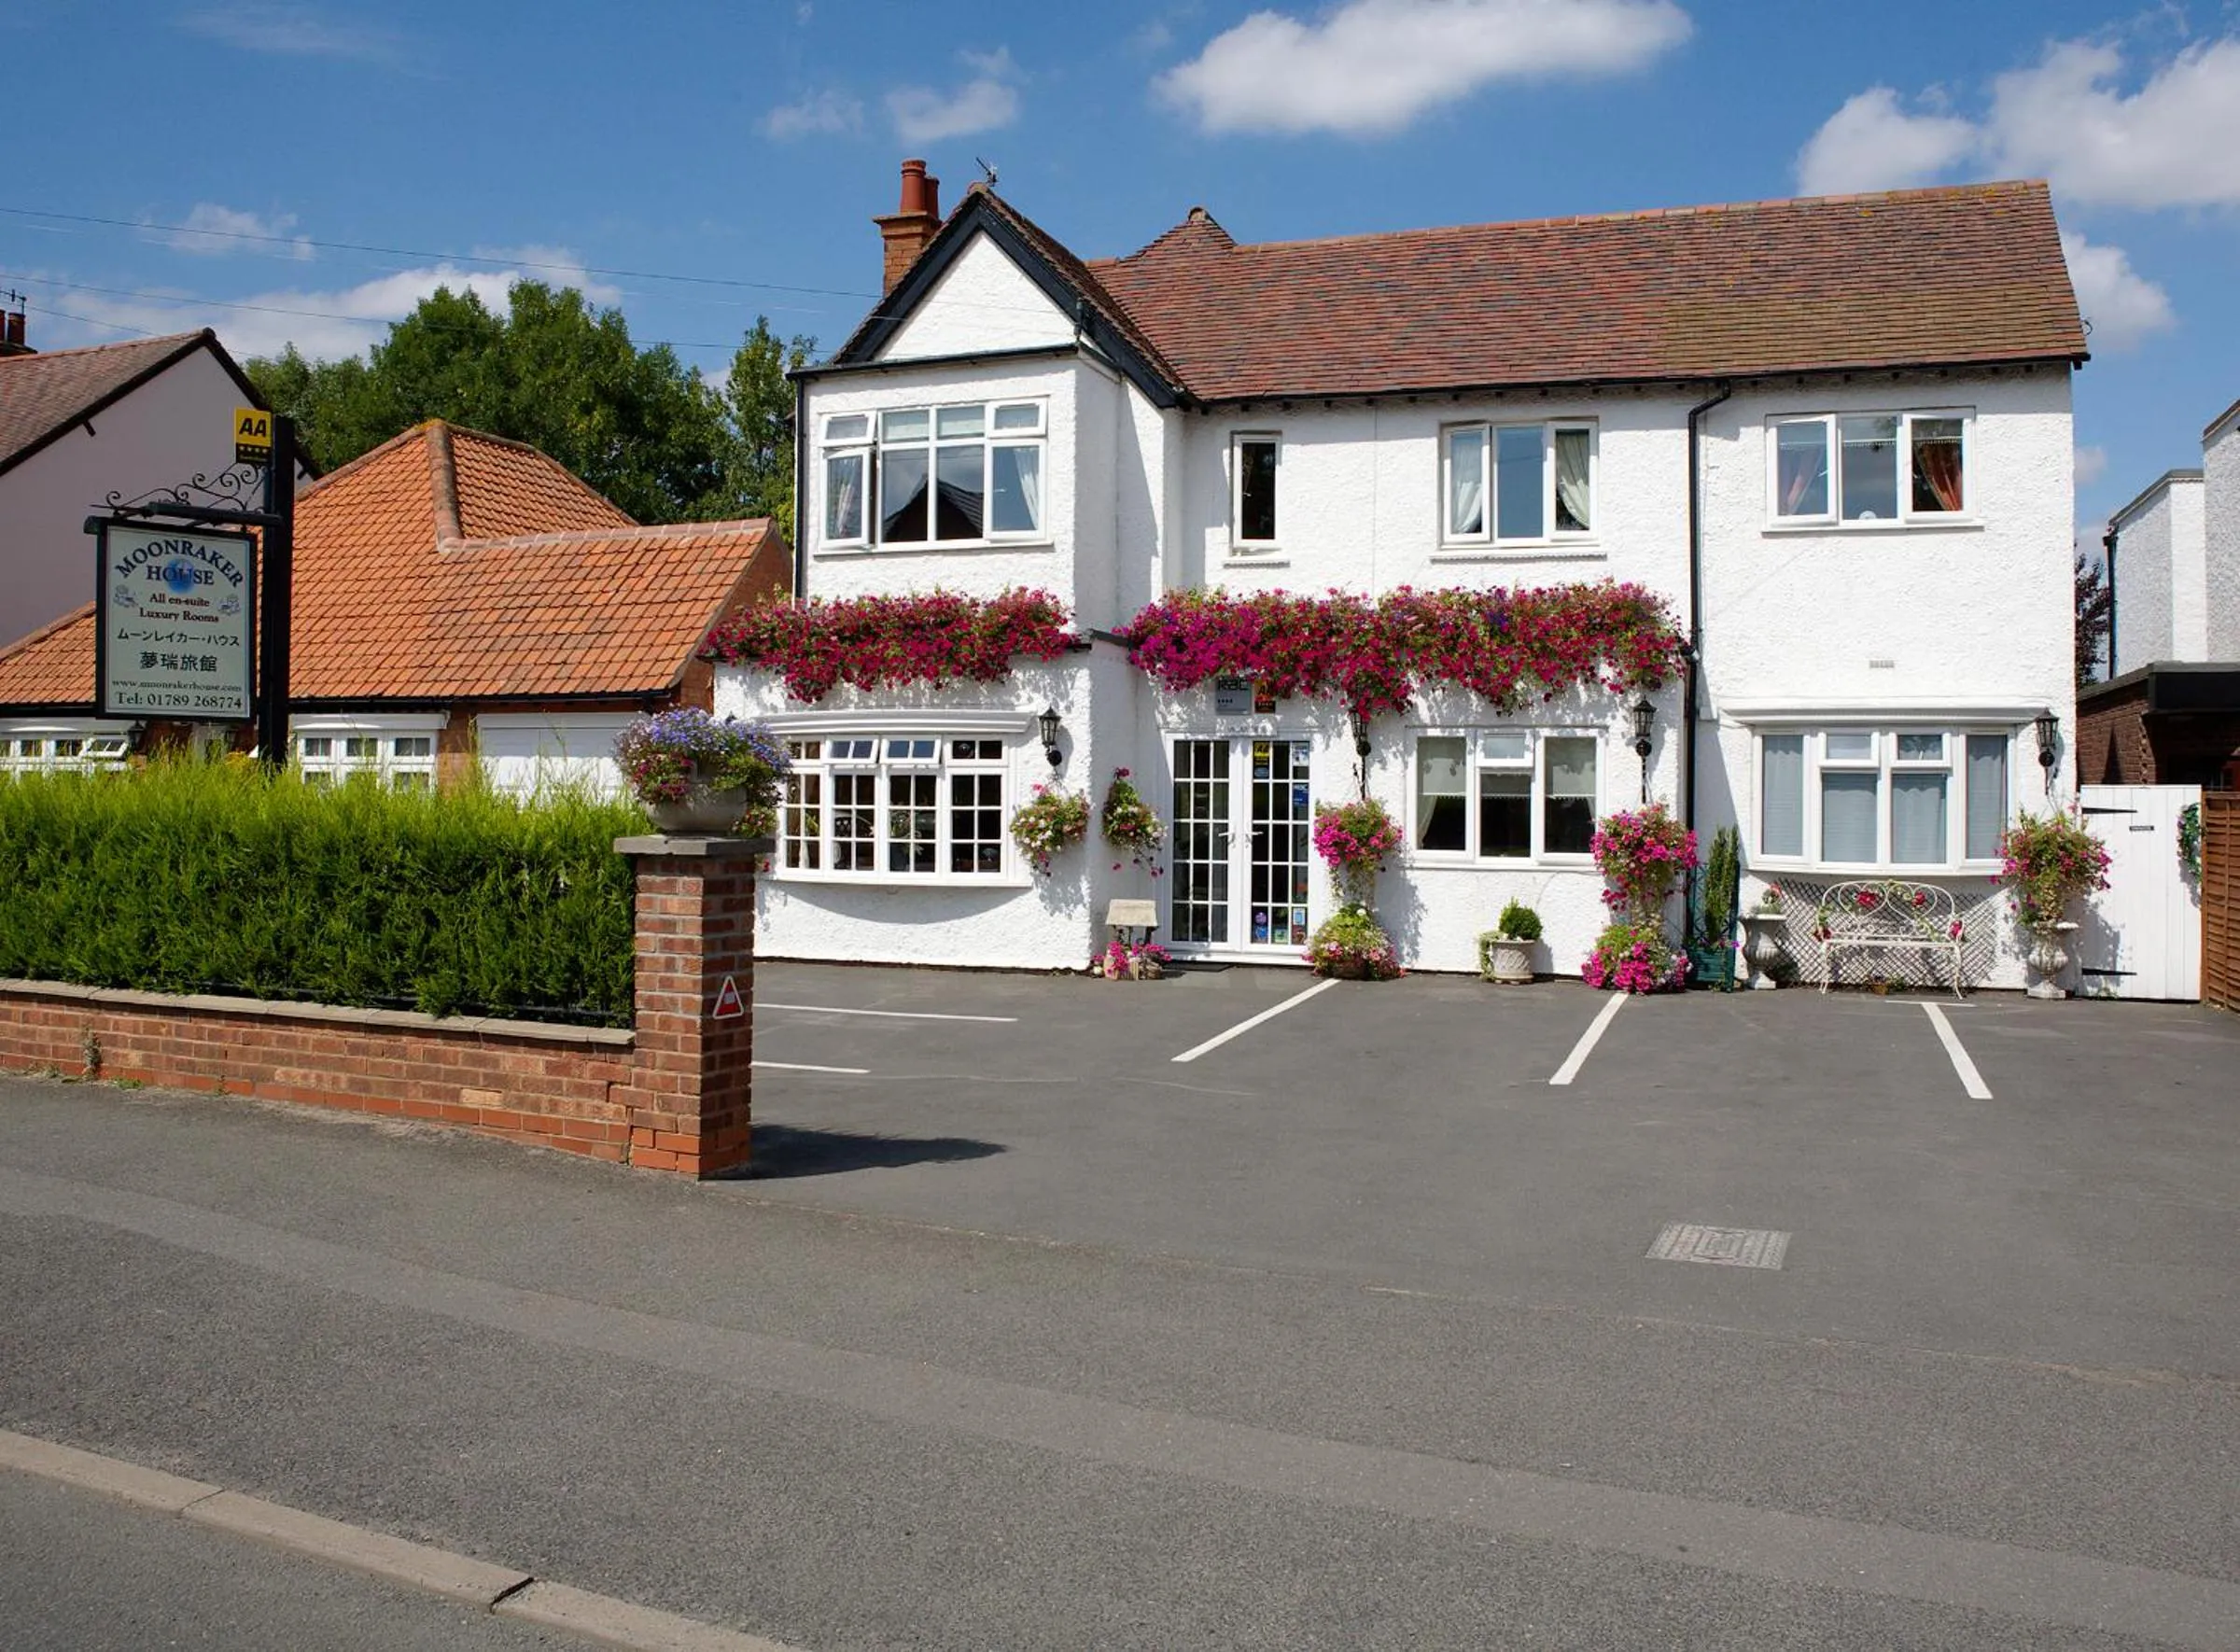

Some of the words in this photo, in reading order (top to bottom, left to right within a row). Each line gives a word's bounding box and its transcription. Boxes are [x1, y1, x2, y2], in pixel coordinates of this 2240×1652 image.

[239, 418, 267, 438] AA
[115, 539, 244, 588] MOONRAKER
[147, 566, 215, 585] HOUSE
[149, 593, 165, 604] All
[168, 597, 210, 608] en-suite
[140, 608, 179, 622] Luxury
[183, 610, 219, 623] Rooms
[139, 651, 217, 673] 夢瑞旅館
[118, 692, 143, 706] Tel:
[147, 693, 190, 707] 01789
[194, 695, 242, 709] 268774
